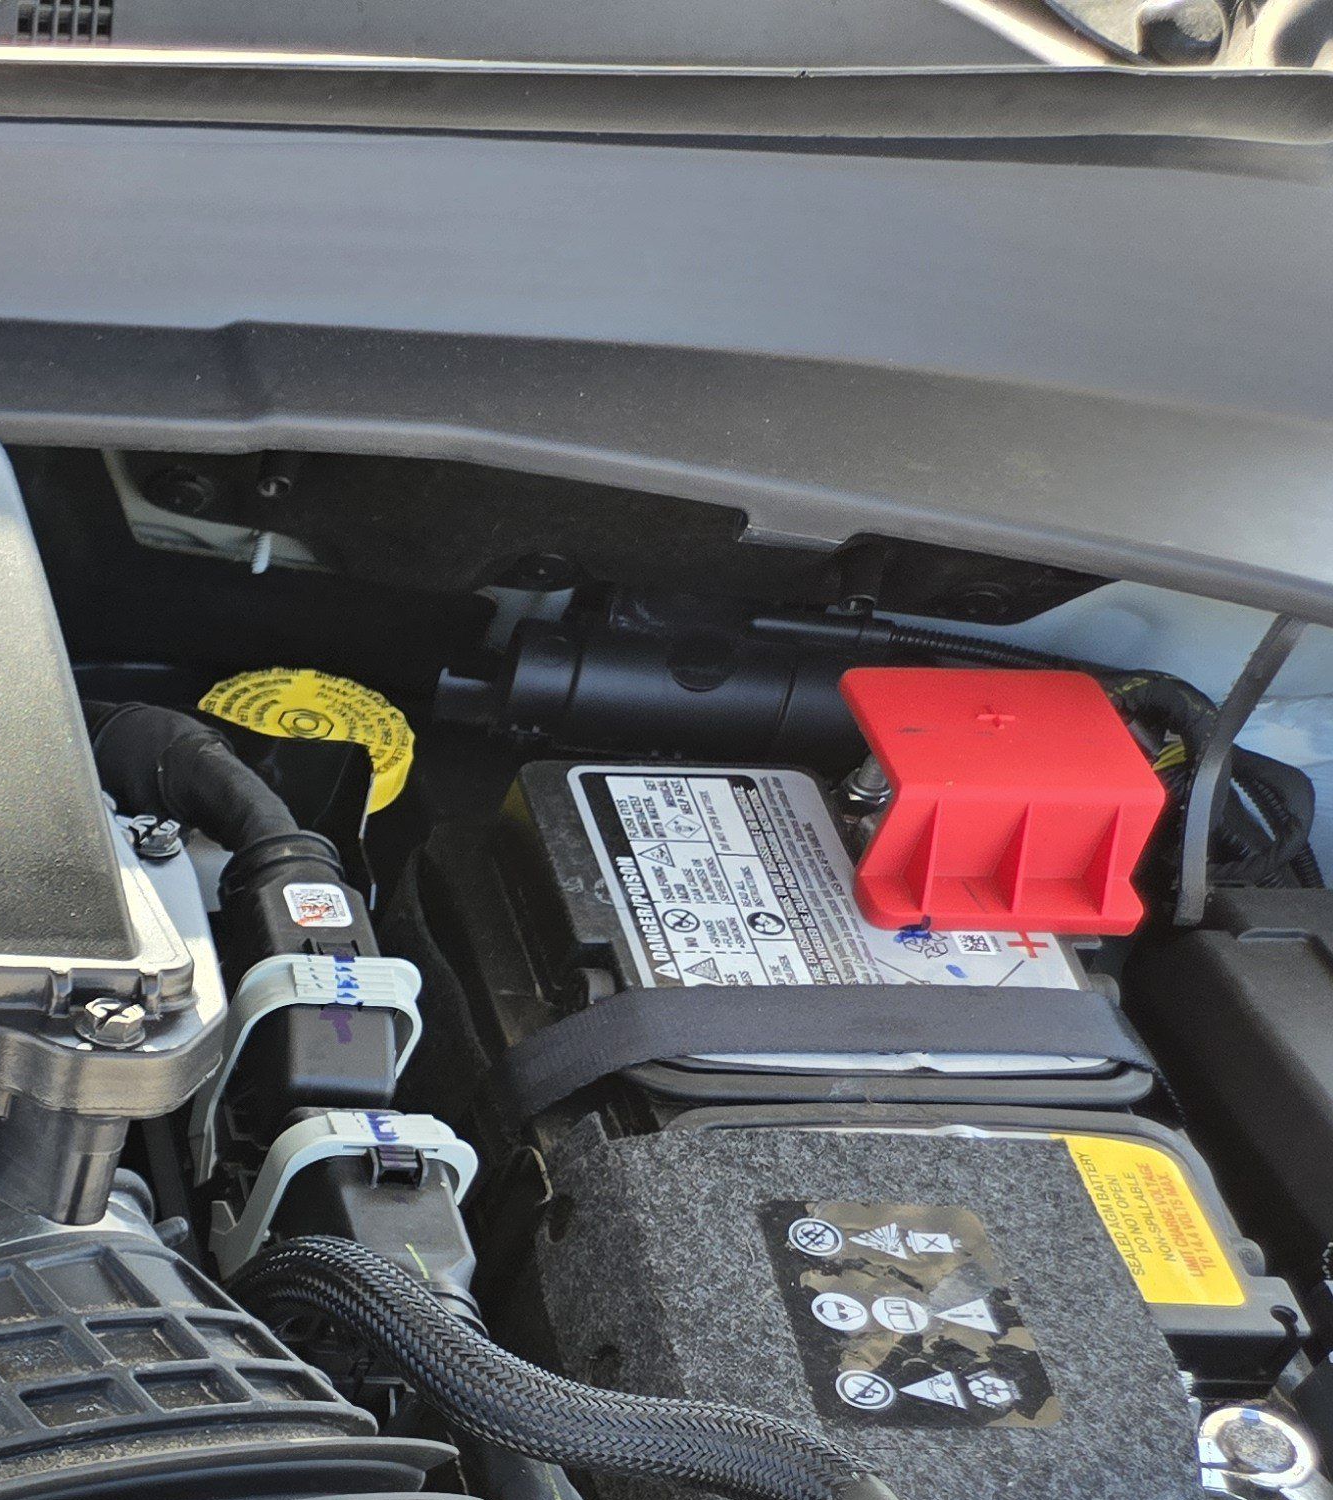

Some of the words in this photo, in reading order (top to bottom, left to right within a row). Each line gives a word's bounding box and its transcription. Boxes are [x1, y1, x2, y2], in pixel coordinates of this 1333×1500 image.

[681, 867, 698, 886] CAUSE
[673, 883, 690, 899] ACID
[689, 888, 704, 900] CAN
[614, 856, 672, 960] DANGER/POISON
[683, 936, 699, 947] NO
[1074, 1151, 1111, 1201] BATTERY
[1134, 1161, 1169, 1205] VOLTAGE
[1102, 1173, 1131, 1209] OPEN!
[1099, 1203, 1124, 1228] AGM
[1120, 1211, 1143, 1234] NOT
[1121, 1171, 1176, 1261] NON-SPILLABLE
[1157, 1206, 1189, 1247] CHARGE
[1168, 1198, 1197, 1231] VOLTS
[1113, 1231, 1146, 1275] SEALED
[1132, 1236, 1152, 1253] DO
[1186, 1232, 1208, 1252] 14.4
[1178, 1249, 1204, 1276] LIMIT
[1197, 1255, 1216, 1268] TO
